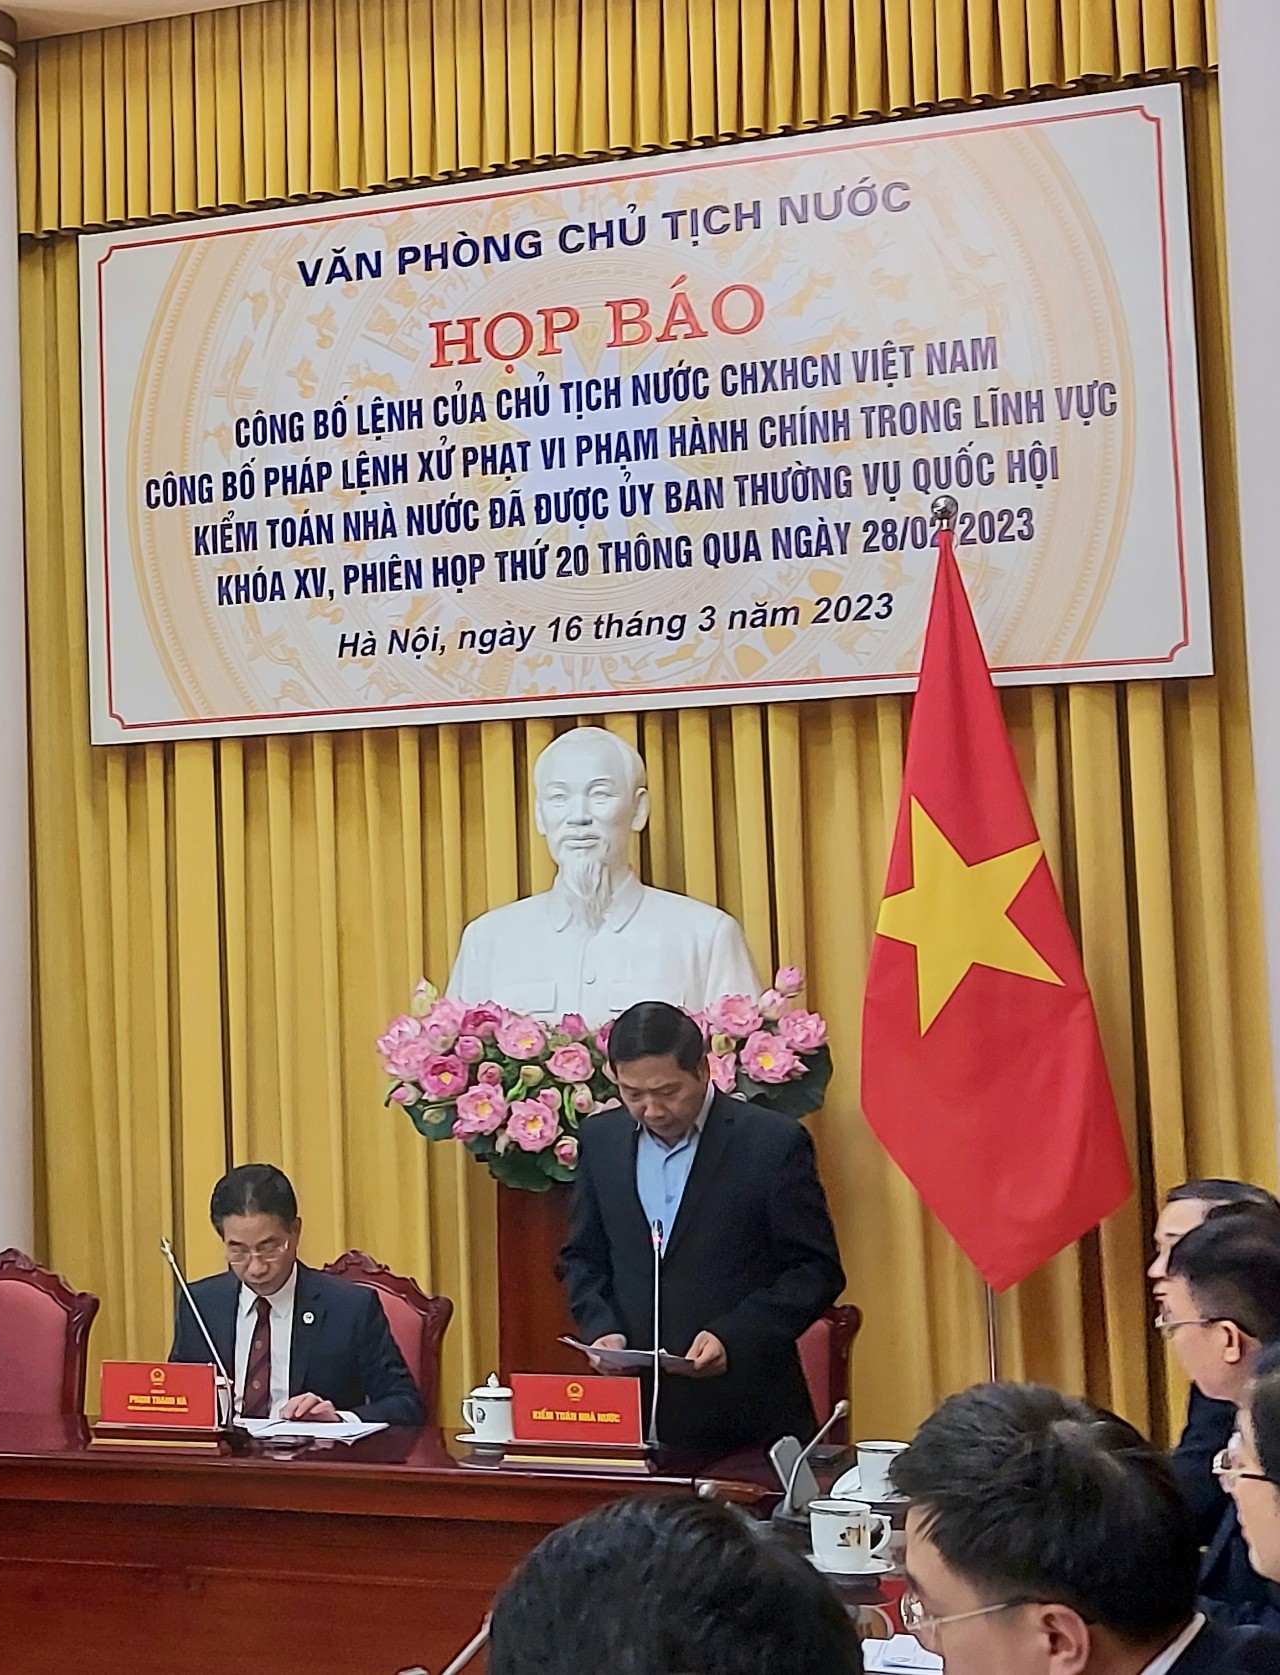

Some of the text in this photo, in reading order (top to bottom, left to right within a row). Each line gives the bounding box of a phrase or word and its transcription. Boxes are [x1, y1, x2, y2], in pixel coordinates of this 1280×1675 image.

[296, 175, 910, 288] VĂN PHÒNG CHỦ TỊCH NƯỚC
[428, 274, 765, 374] HỌP BÁO
[145, 379, 1118, 510] CÔNG BỐ PHÁP LỆNH XỬ PHẠT VI PHẠM HÀNH CHÍNH TRONG LĨNH VỰC
[235, 336, 998, 449] CÔNG BỐ LỆNH CỦA CHỦ TỊCH NƯỚC CHXHCN VIỆT NAM
[193, 439, 1059, 557] KIỂM TOÁN NHÀ NƯỚC ĐÃ ĐƯỢC ỦY BAN THƯỜNG VỤ QUỐC HỘI
[216, 564, 286, 606] KHÓA
[293, 566, 335, 600] XV,
[342, 552, 423, 596] PHIÊN
[432, 552, 486, 594] HỌP
[493, 537, 550, 583] THỨ
[555, 544, 590, 578] 20
[597, 531, 693, 574] THÔNG
[702, 528, 763, 570] QUA
[771, 515, 852, 561] NGÀY
[337, 592, 895, 661] Hà Nội, ngày 16 tháng 3 năm 2023
